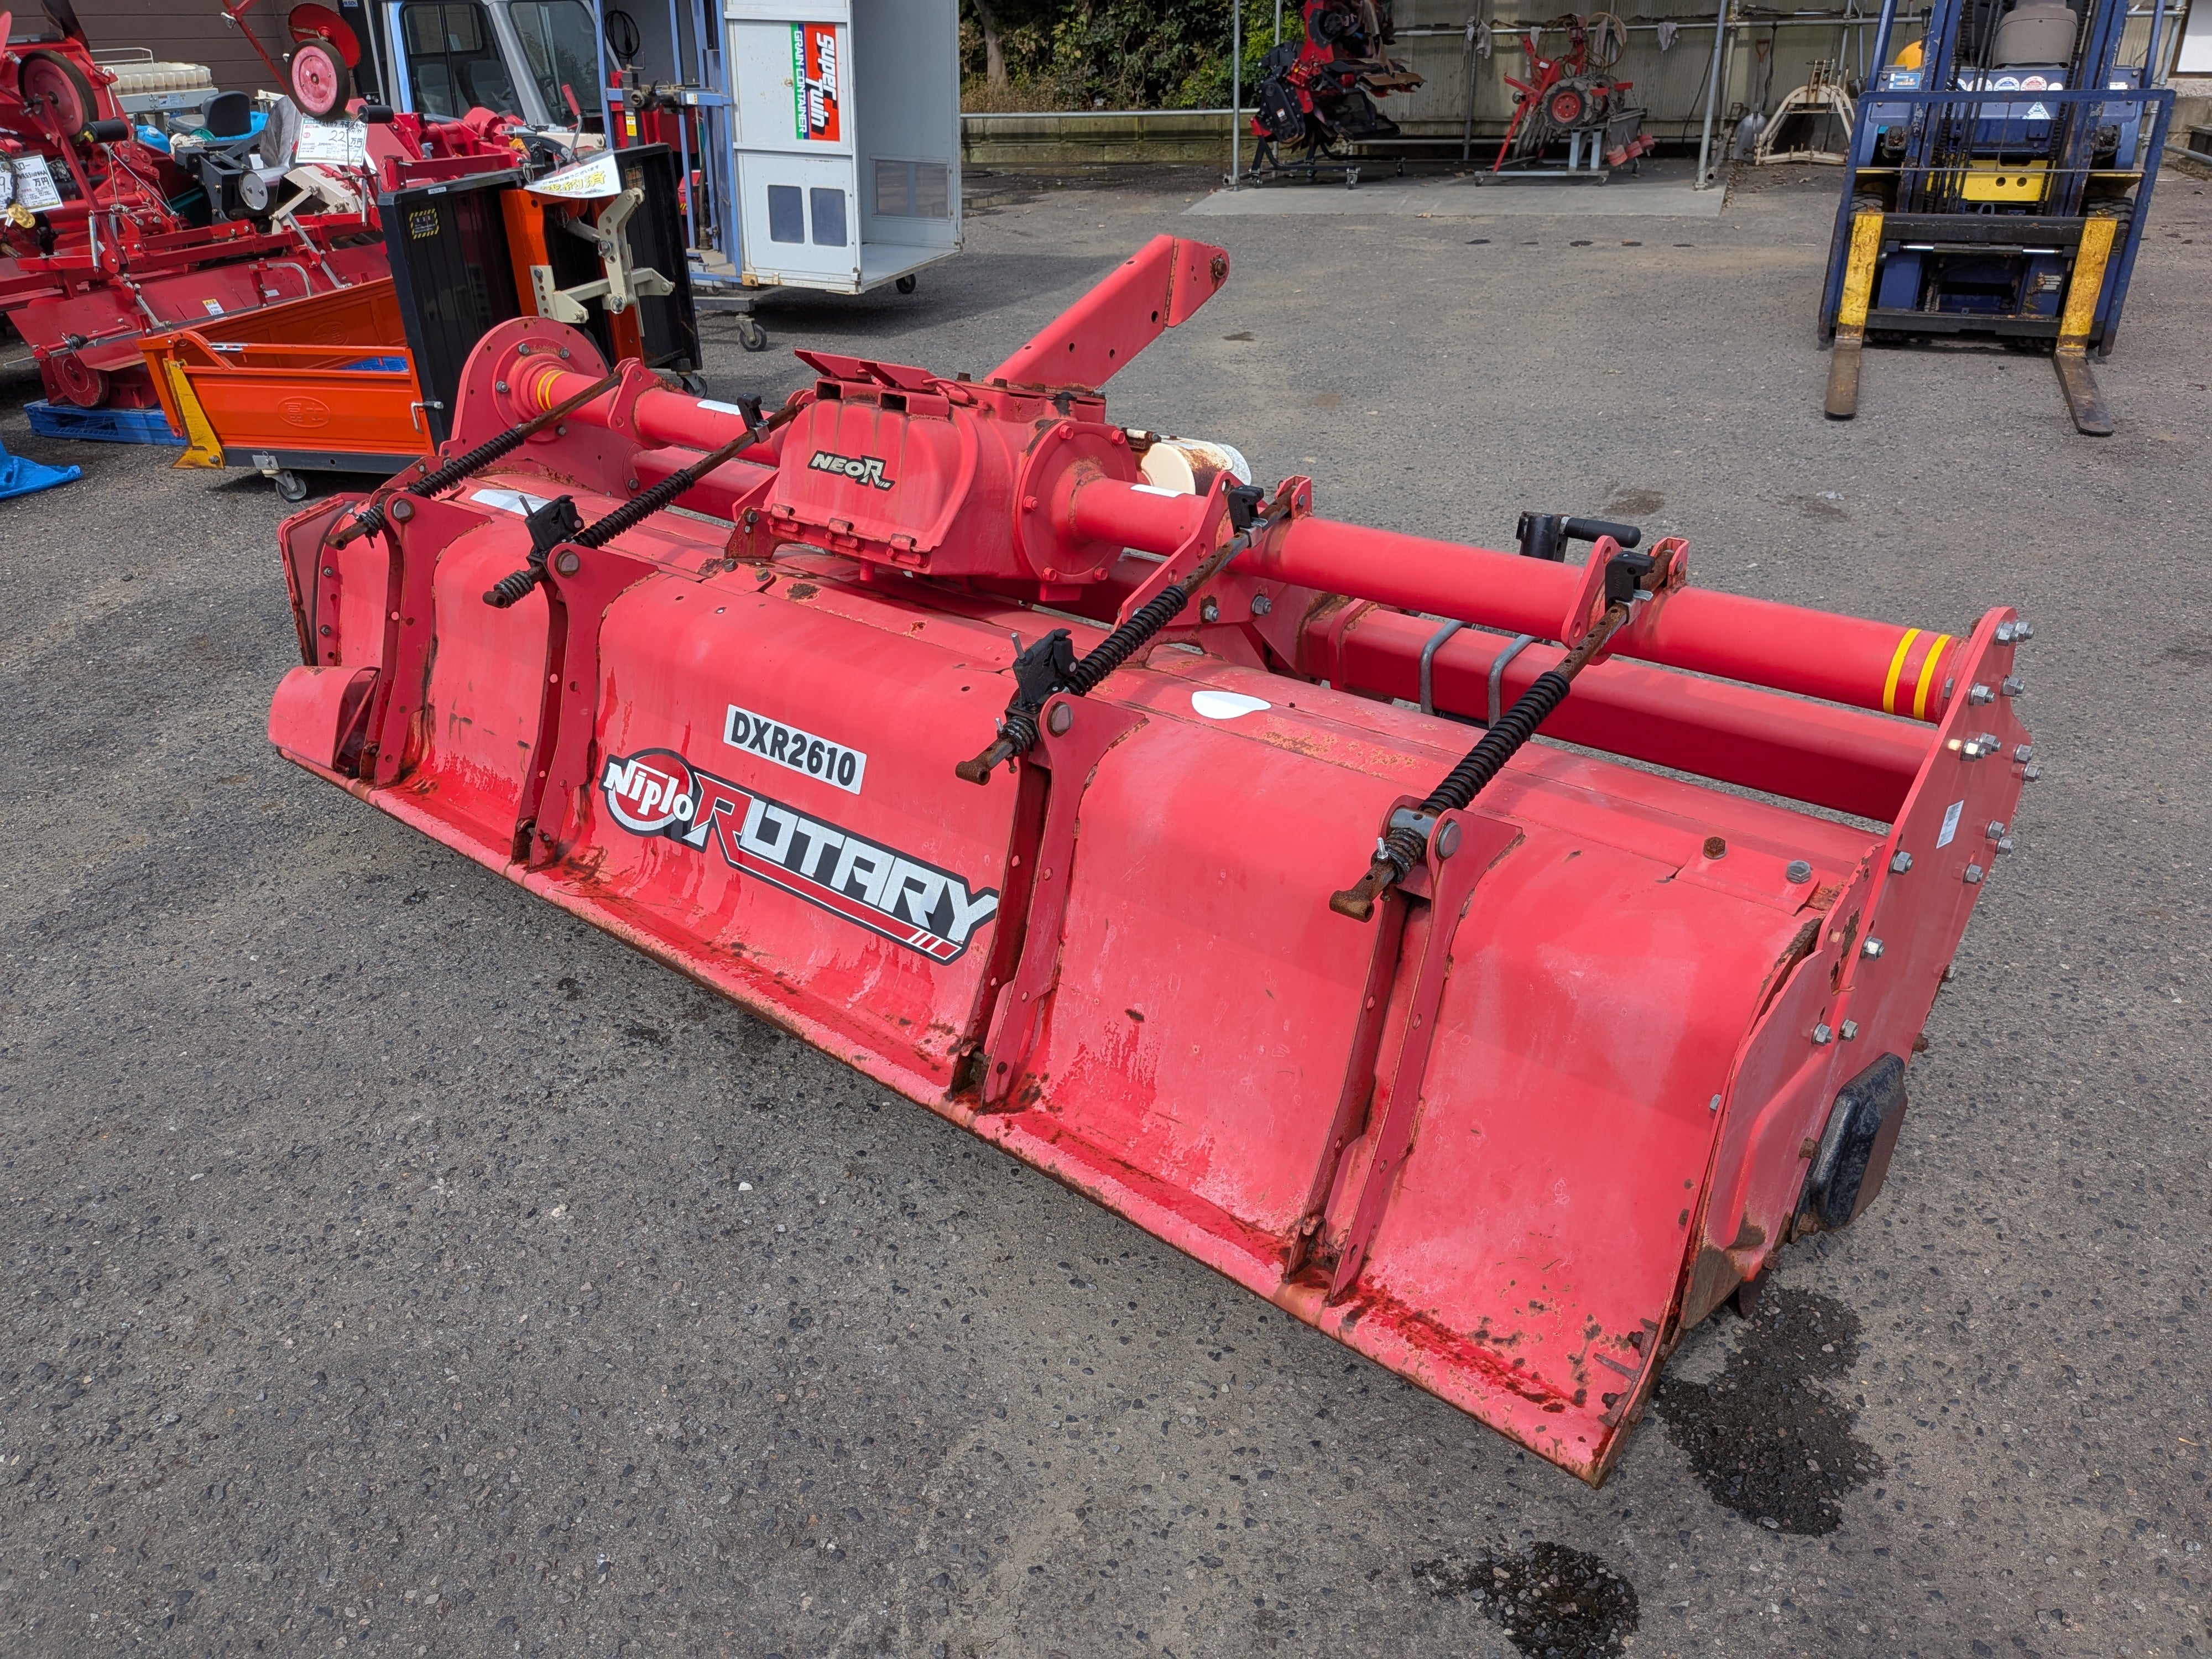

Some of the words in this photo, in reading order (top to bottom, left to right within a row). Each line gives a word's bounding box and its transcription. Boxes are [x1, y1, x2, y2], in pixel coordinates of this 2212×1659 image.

[794, 31, 804, 65] GRAIN
[817, 32, 837, 101] Super
[796, 68, 807, 133] CONTAINER
[805, 77, 829, 127] Twin
[328, 130, 346, 143] 22
[33, 177, 50, 186] 万円
[810, 453, 891, 488] NEOR
[729, 711, 857, 786] DXR2610
[603, 759, 694, 822] Niplo
[682, 771, 999, 961] ROTARY
